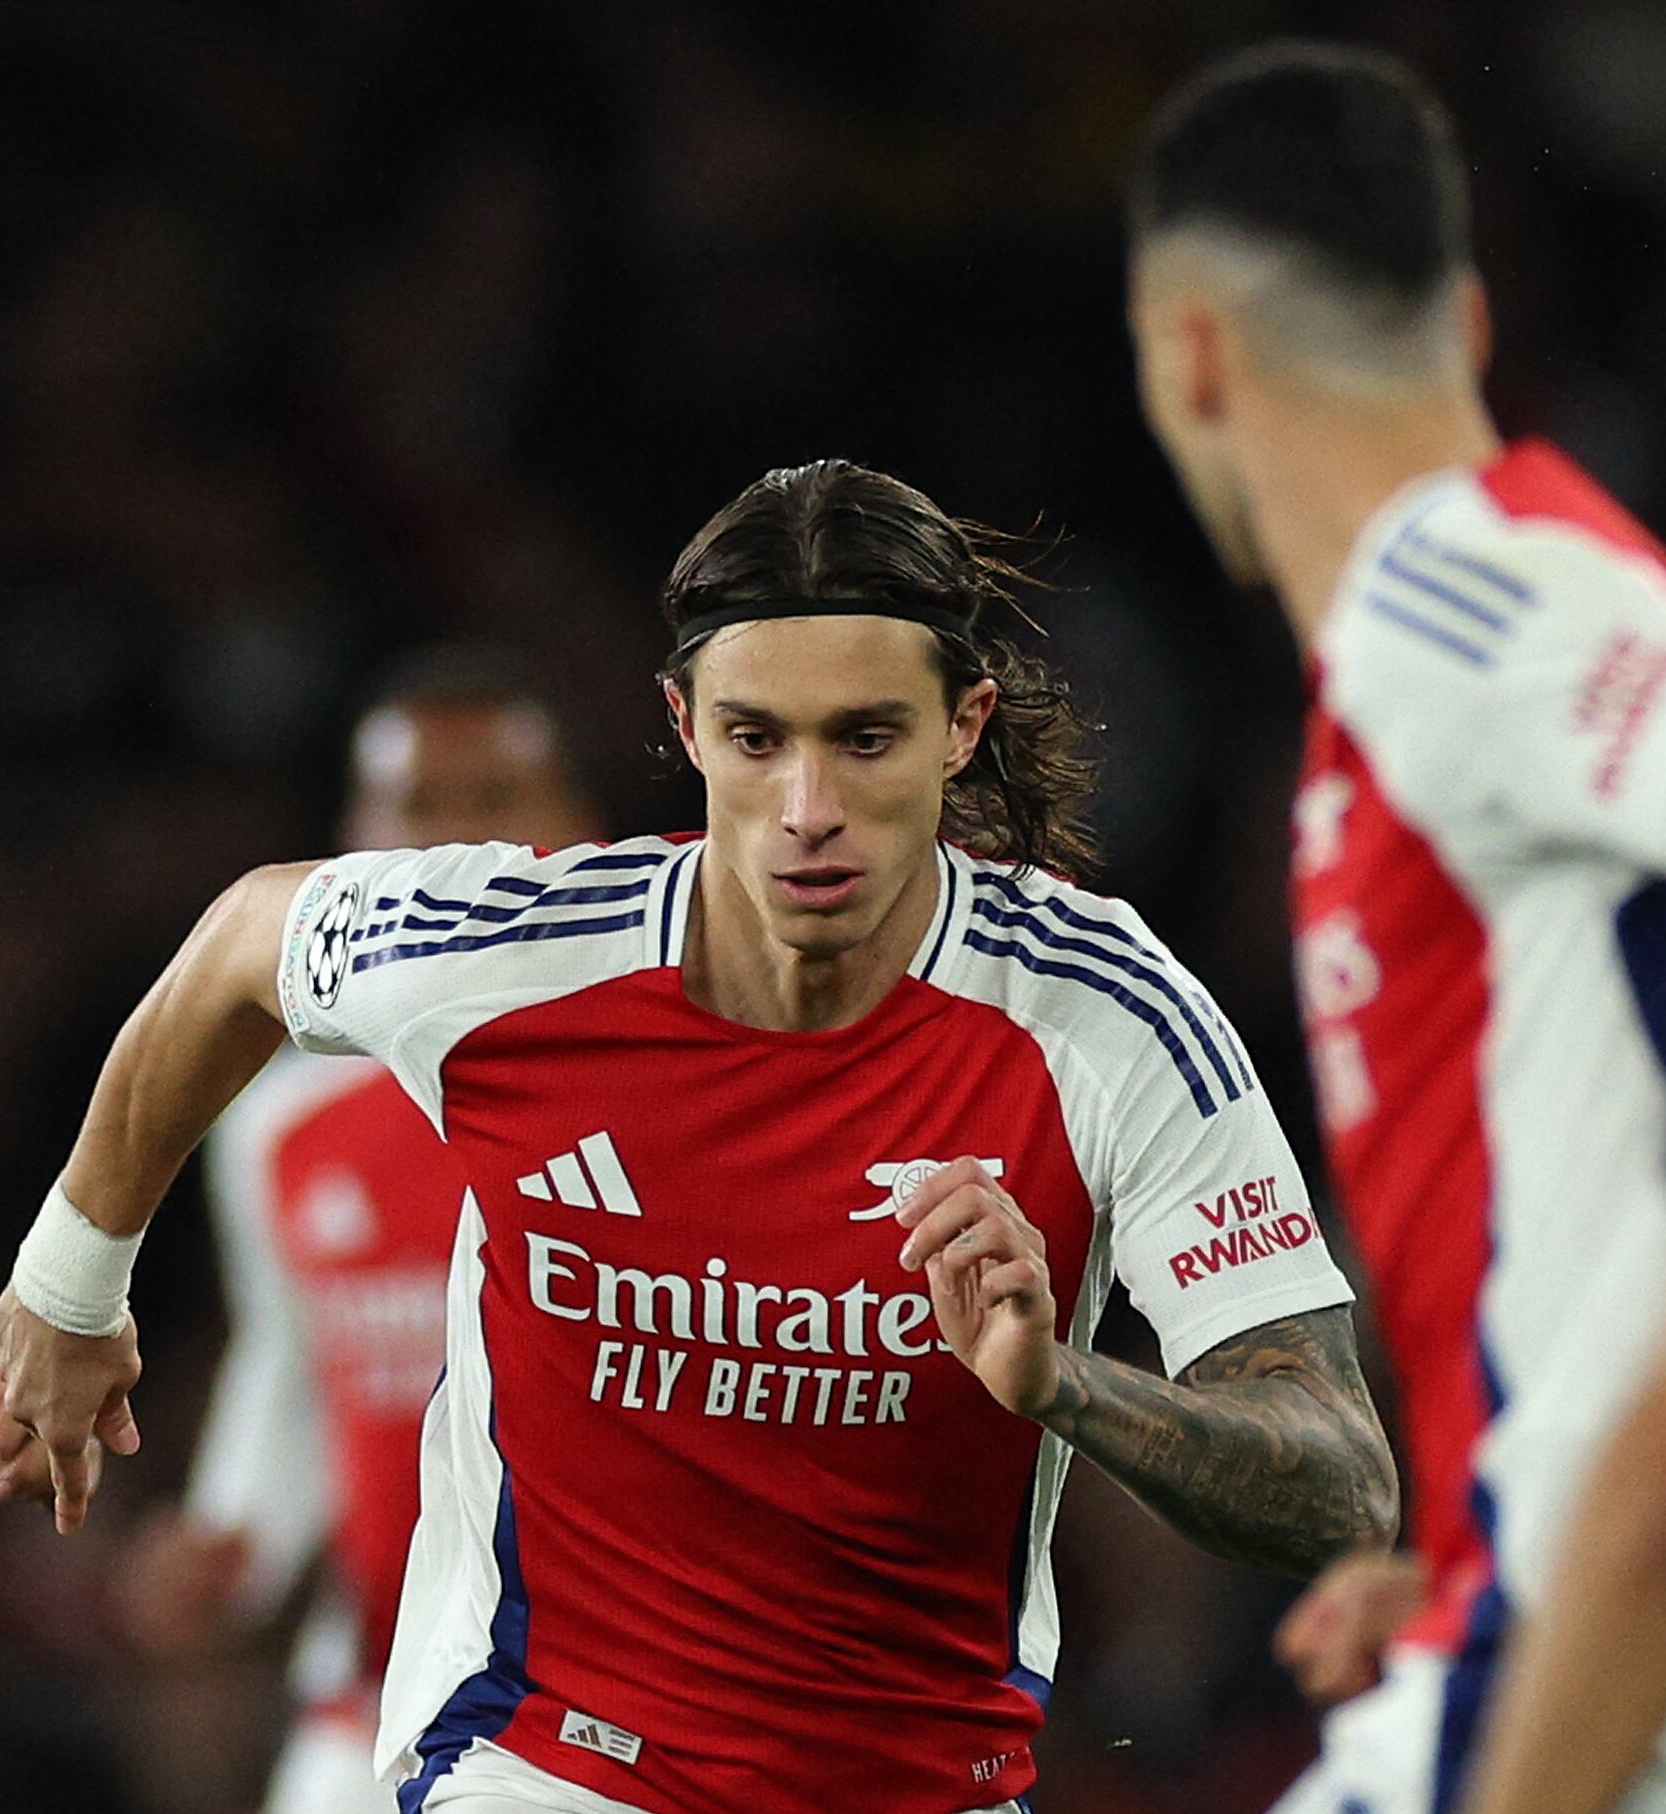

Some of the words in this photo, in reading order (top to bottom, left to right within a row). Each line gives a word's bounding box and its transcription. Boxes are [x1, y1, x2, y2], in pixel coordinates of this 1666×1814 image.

[1195, 1175, 1279, 1229] VISIT
[524, 1231, 954, 1358] Emirate
[590, 1340, 688, 1412] FLY
[704, 1357, 912, 1426] BETTER
[972, 1751, 1016, 1784] HEAT
